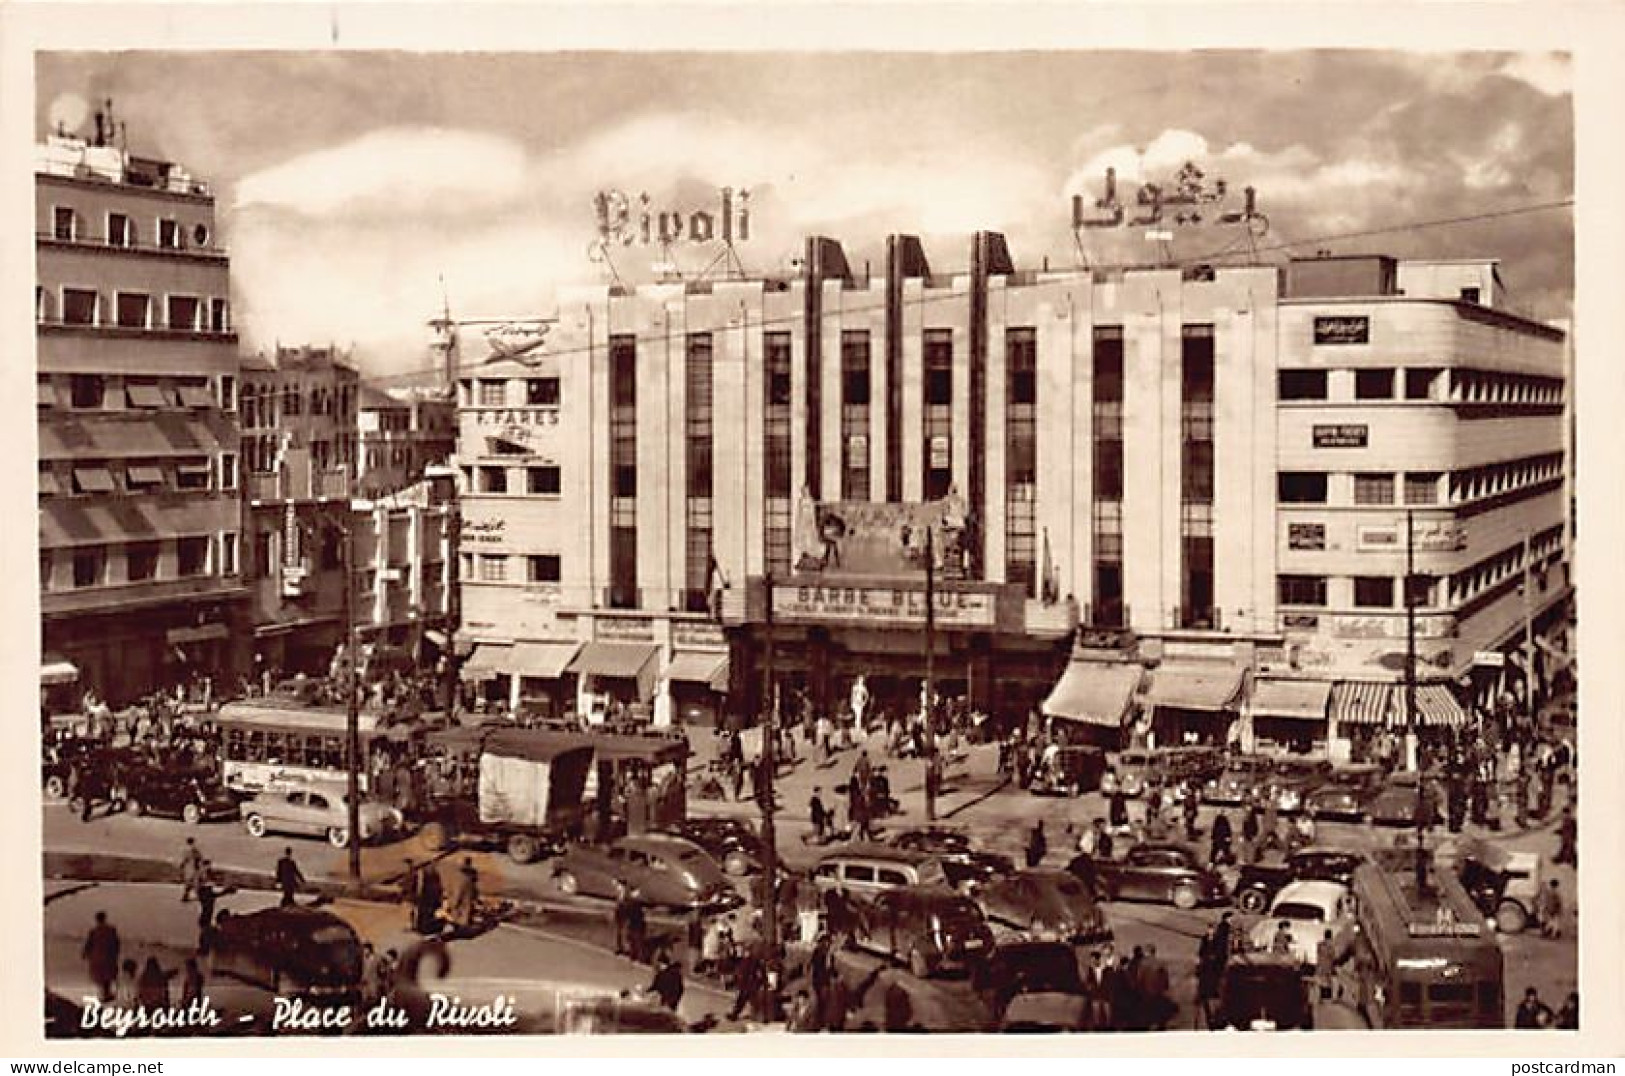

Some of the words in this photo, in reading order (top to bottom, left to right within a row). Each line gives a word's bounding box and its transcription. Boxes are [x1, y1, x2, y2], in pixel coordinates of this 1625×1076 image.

[594, 187, 749, 247] Rivoli
[798, 586, 869, 606] BARBE
[892, 588, 968, 609] BLUE
